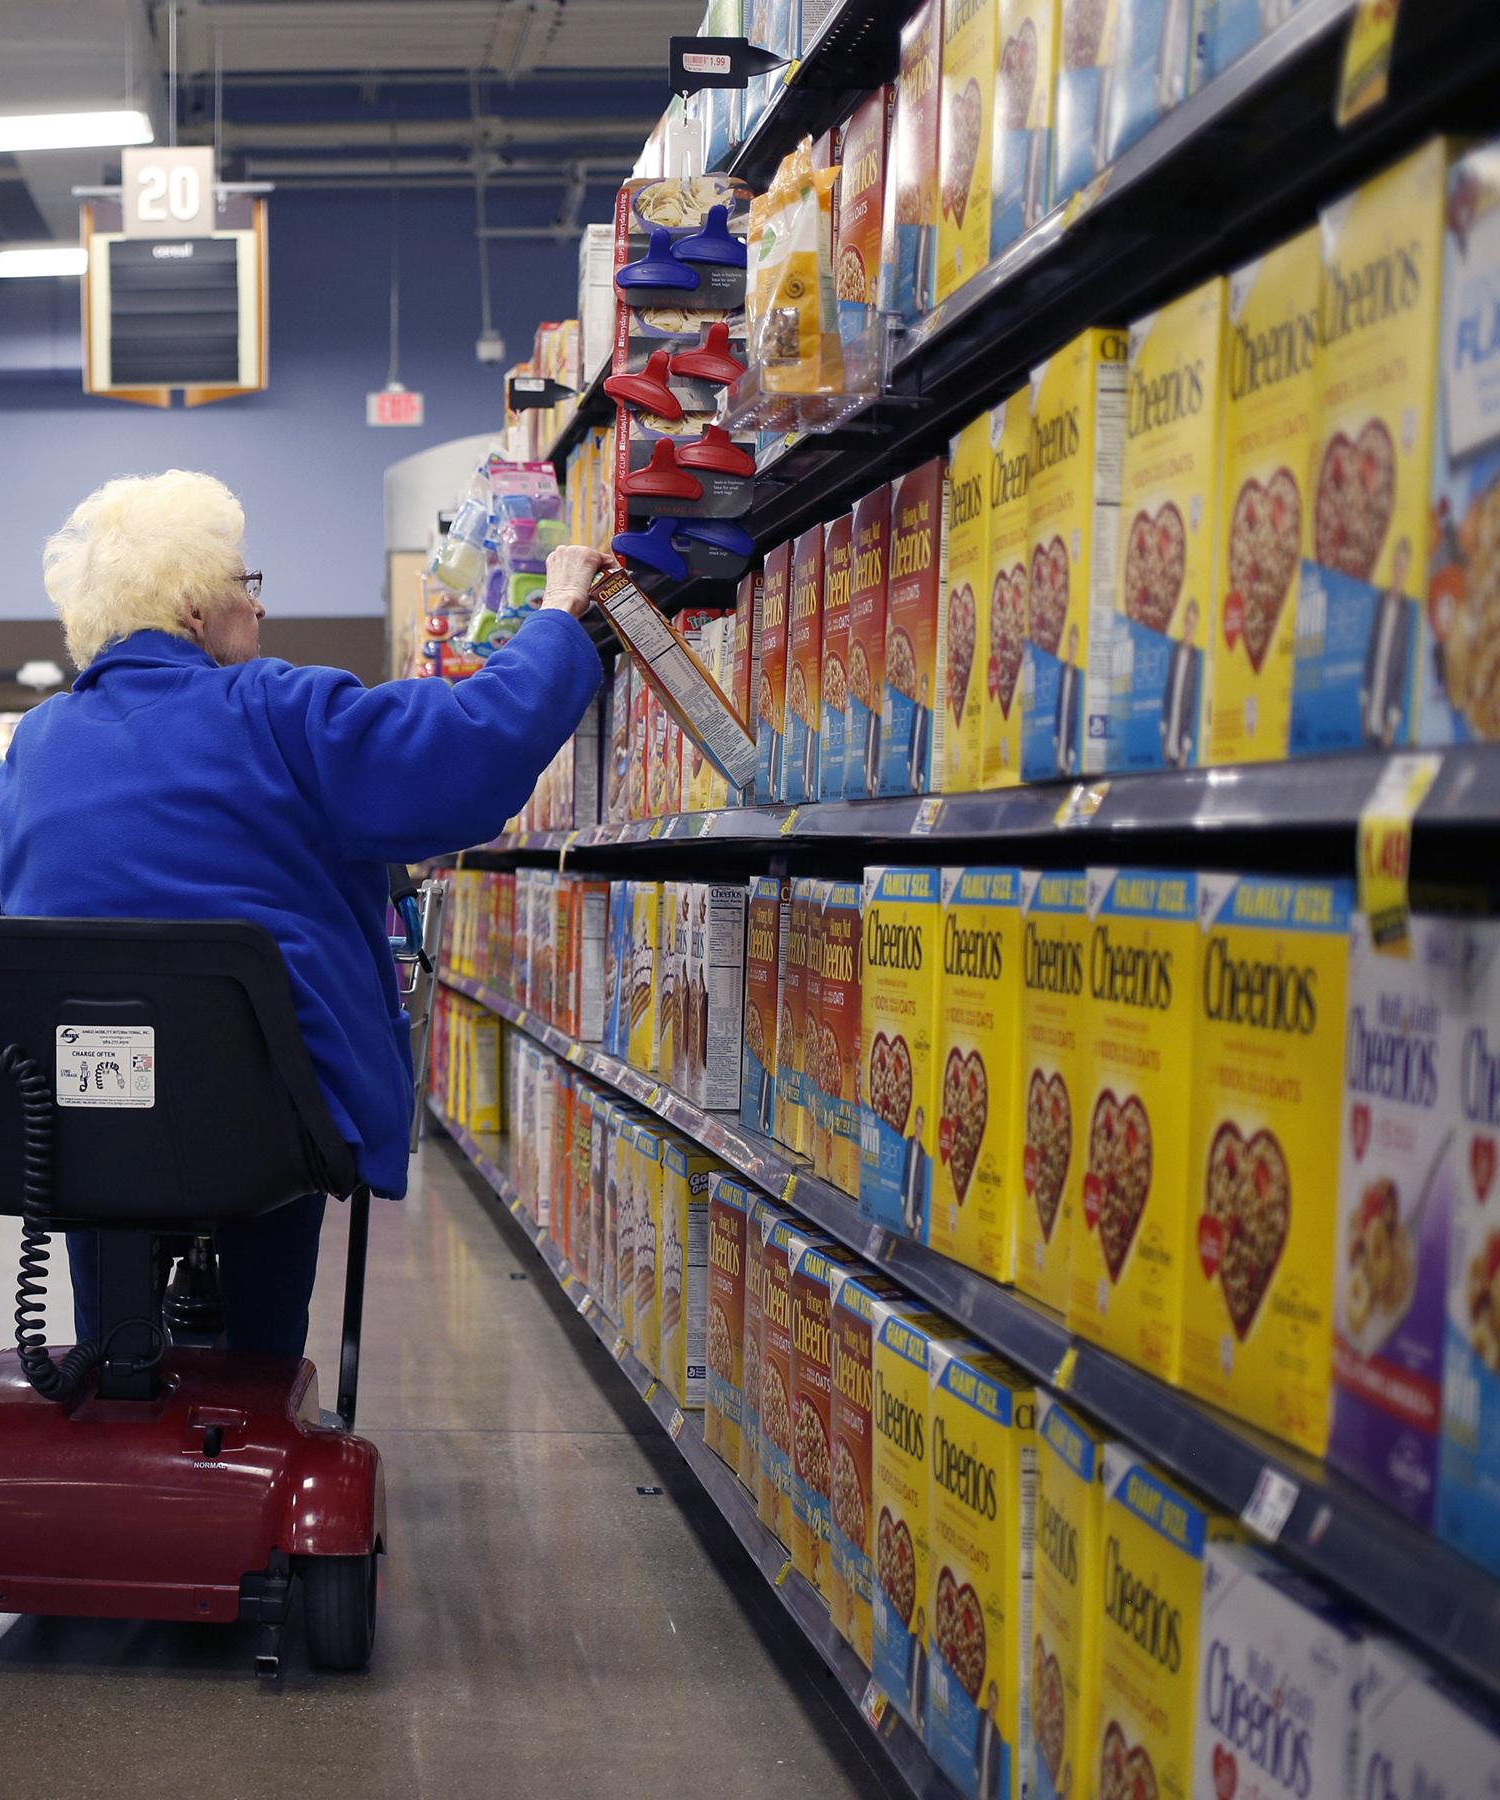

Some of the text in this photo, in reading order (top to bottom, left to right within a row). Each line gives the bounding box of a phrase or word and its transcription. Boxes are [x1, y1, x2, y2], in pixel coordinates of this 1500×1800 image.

[710, 57, 726, 66] 1.99
[137, 164, 200, 221] 20
[620, 192, 628, 212] Living.
[619, 212, 627, 239] Everyday
[1325, 240, 1420, 346] Cheerios
[1230, 307, 1318, 401] Cheerios
[1127, 358, 1204, 440] Cheerios
[889, 527, 932, 580] Cheerios
[600, 577, 629, 602] Cheerios
[711, 889, 742, 899] Cheerios
[883, 873, 930, 897] FAMILY SIZE
[961, 875, 1012, 899] FAMILY SIZE
[821, 932, 852, 982] Cheerios
[868, 909, 922, 970] Cheerios
[944, 914, 1002, 980] Cheerios
[1024, 922, 1082, 996] Cheerios
[1092, 926, 1172, 1010] Cheerios
[900, 999, 916, 1016] OATS
[1205, 936, 1318, 1036] Cheerios
[1349, 1006, 1439, 1108] Cheerios
[719, 1181, 743, 1207] GIANT SIZE
[709, 1220, 740, 1277] Cheerios
[804, 1252, 822, 1279] GIANT
[885, 1317, 926, 1362] GIANT SIZE
[815, 1374, 831, 1393] OATS
[832, 1333, 872, 1412] Cheerios
[948, 1363, 998, 1414] GIANT SIZE
[875, 1369, 925, 1462] Cheerios
[933, 1416, 997, 1522] Cheerios
[1106, 1536, 1181, 1674] Cheerios
[1207, 1638, 1312, 1800] Cheerios
